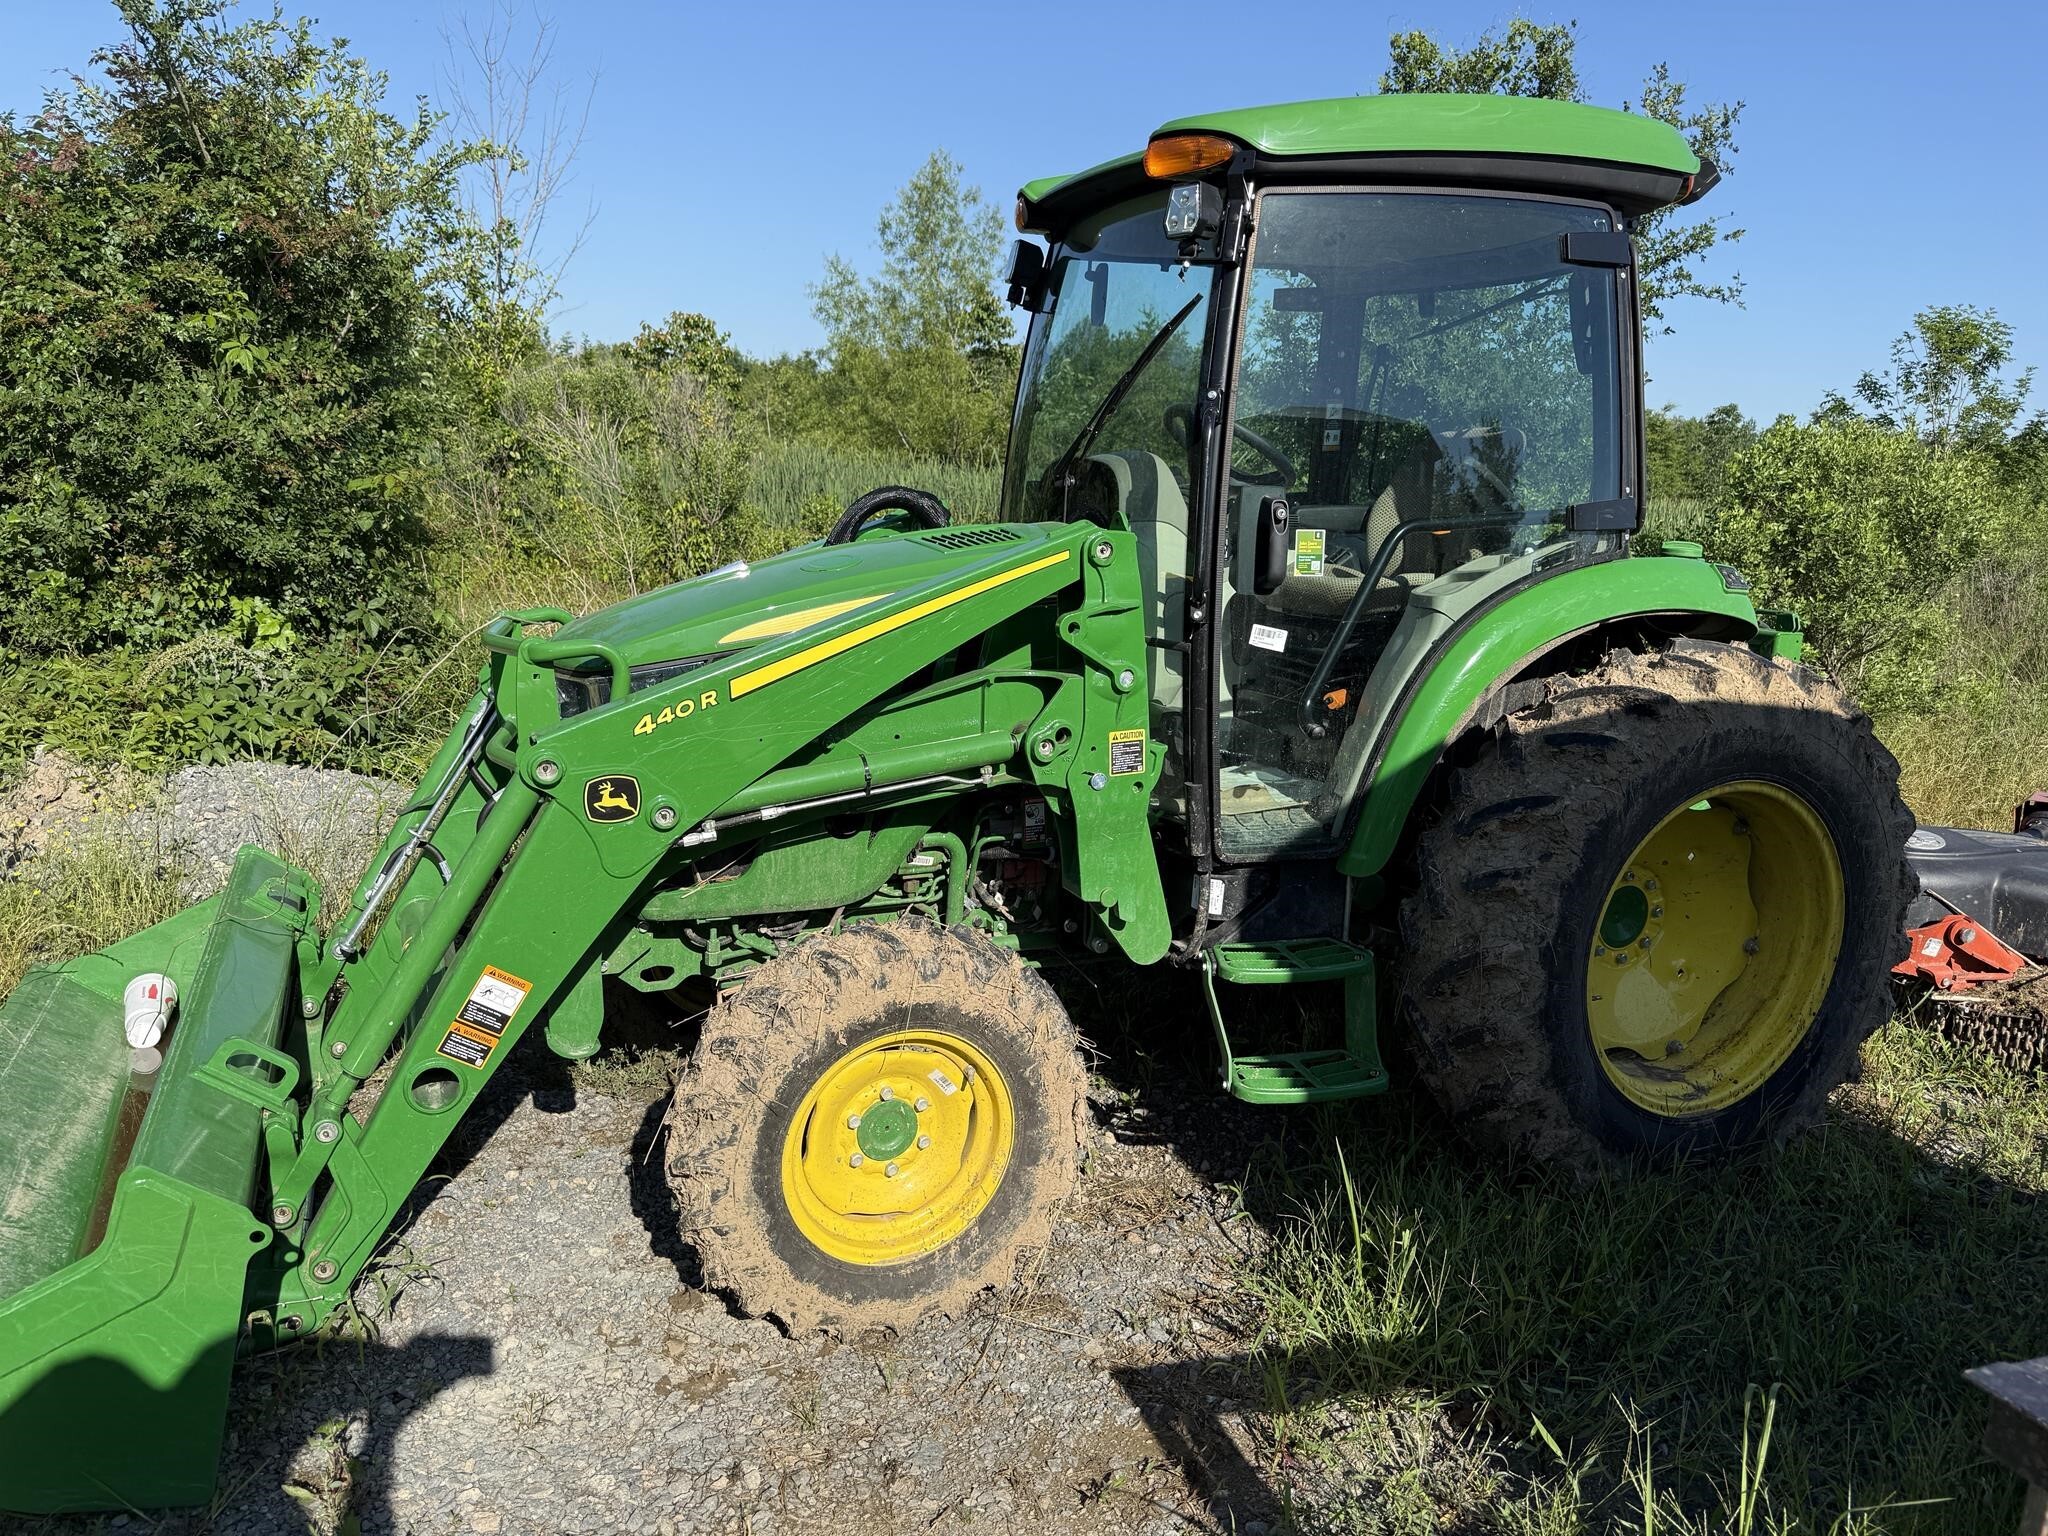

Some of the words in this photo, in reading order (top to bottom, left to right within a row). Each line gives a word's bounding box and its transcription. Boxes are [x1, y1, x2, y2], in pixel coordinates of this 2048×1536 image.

[633, 699, 695, 737] 440
[700, 689, 719, 711] R
[1120, 731, 1144, 740] CAUTION
[497, 972, 526, 989] WARNING
[463, 1028, 493, 1045] WARNING
